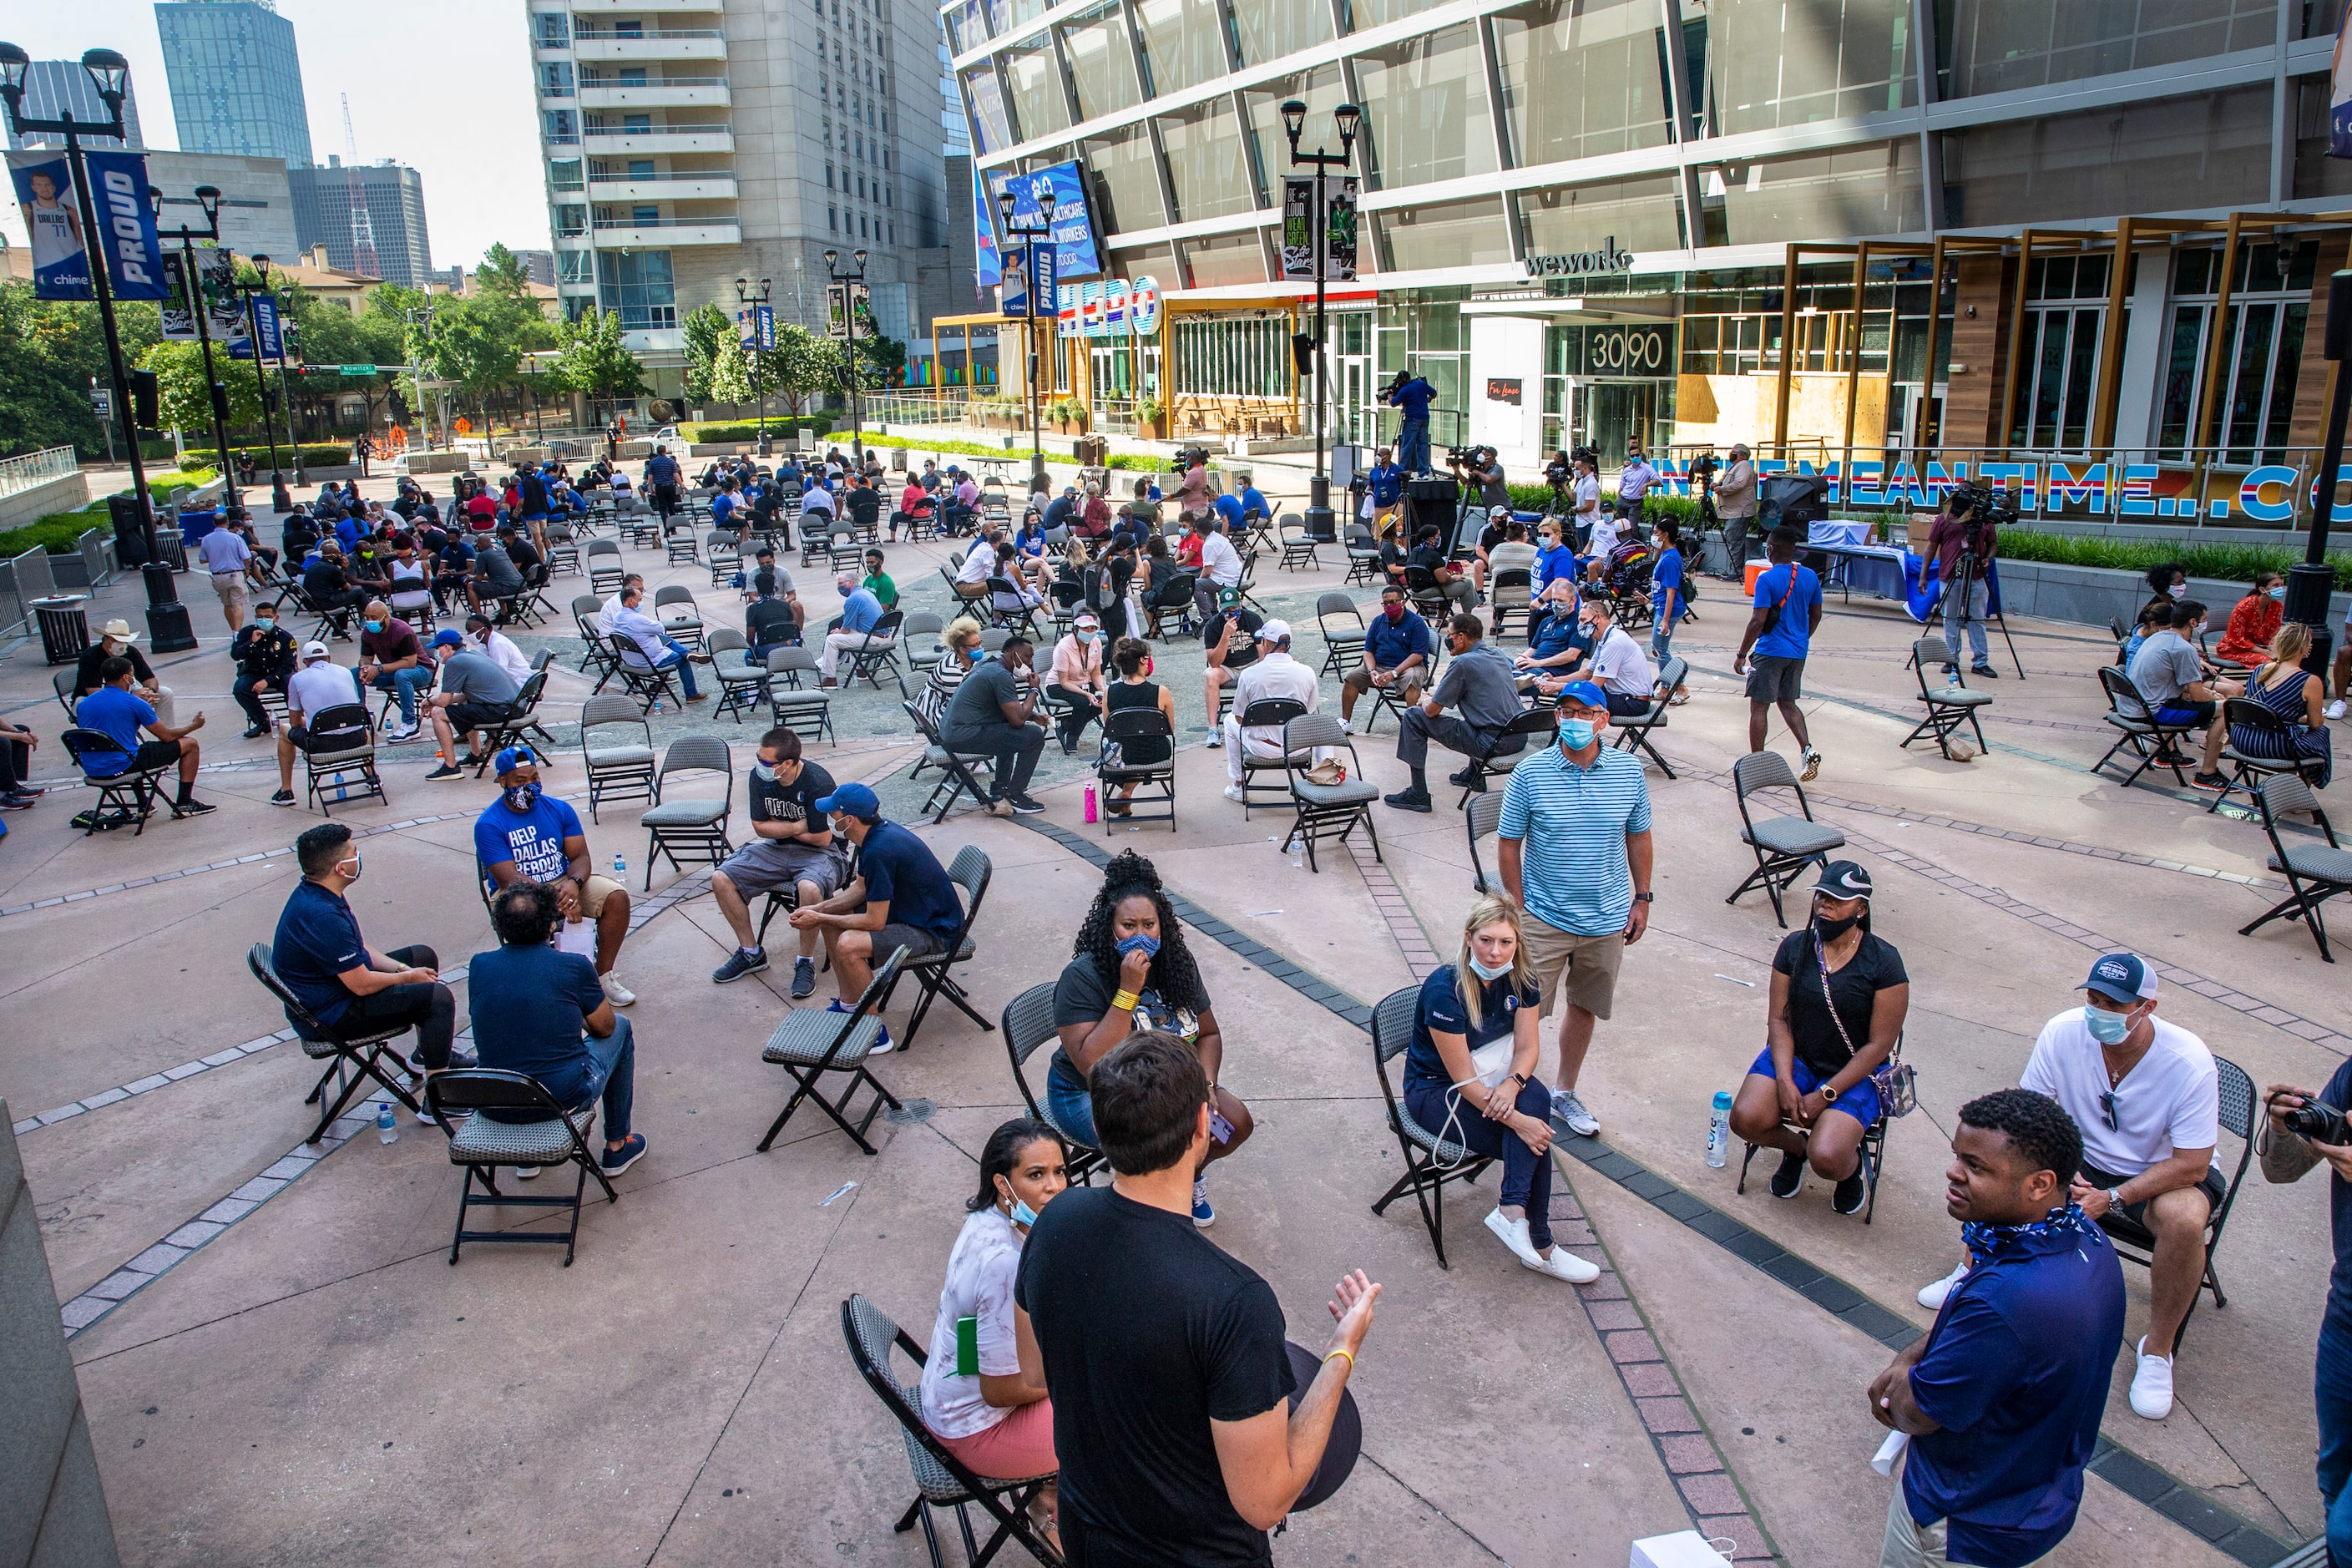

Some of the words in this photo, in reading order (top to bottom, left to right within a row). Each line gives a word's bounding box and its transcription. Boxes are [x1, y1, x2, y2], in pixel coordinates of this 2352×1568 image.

[1287, 187, 1297, 202] BE
[38, 214, 65, 225] DALLAS
[1015, 213, 1035, 229] THANK
[1051, 201, 1085, 223] EALTHCARE
[1287, 203, 1307, 217] LOUD.
[52, 225, 67, 238] 77
[104, 170, 153, 285] PROUD
[1057, 225, 1088, 243] WORKERS
[1287, 217, 1306, 231] WEAR
[1287, 231, 1310, 245] GREEN.
[1284, 246, 1313, 271] Stars
[1522, 235, 1629, 277] wework
[54, 274, 89, 286] chime
[1039, 251, 1054, 310] PROUD
[259, 303, 278, 352] PROUD
[761, 310, 771, 346] ROWDY
[1592, 332, 1662, 368] 3090
[1489, 381, 1501, 395] For
[508, 825, 537, 847] HELP
[513, 837, 558, 863] DALLAS
[1707, 1117, 1717, 1151] core
